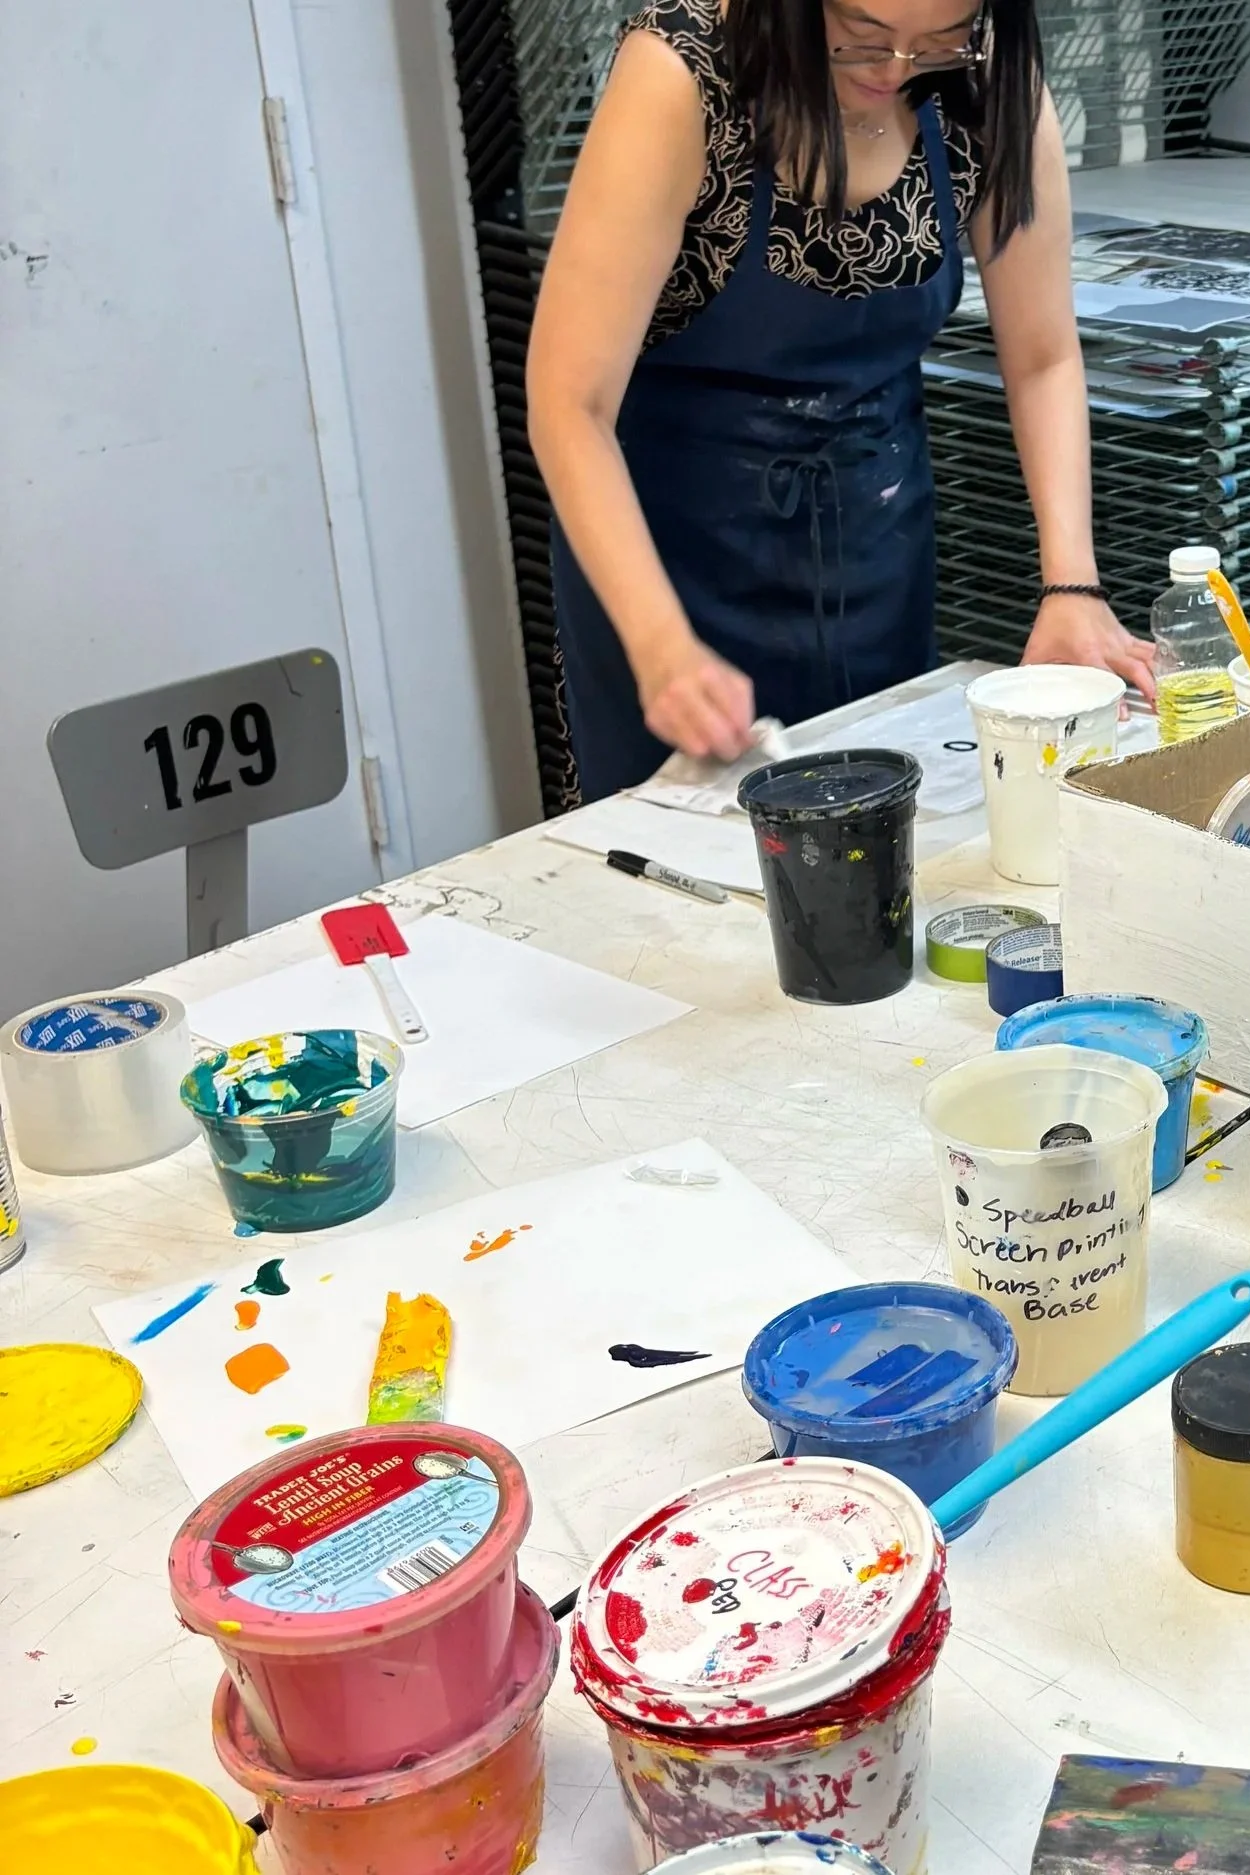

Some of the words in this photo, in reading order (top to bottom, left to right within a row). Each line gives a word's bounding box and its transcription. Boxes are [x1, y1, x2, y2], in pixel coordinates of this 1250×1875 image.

[144, 702, 277, 810] 129
[65, 1029, 86, 1049] LUX
[983, 1190, 1116, 1233] Speedball
[955, 1220, 1048, 1263] Screen
[1023, 1292, 1101, 1321] Base
[251, 1521, 274, 1541] WITH
[278, 1482, 349, 1527] Ancient
[346, 1455, 404, 1489] Grains
[253, 1476, 309, 1507] TRADER
[309, 1453, 347, 1479] JOE'S
[264, 1481, 320, 1516] Lentil
[316, 1461, 363, 1488] Soup
[302, 1507, 333, 1527] HIGH
[333, 1500, 347, 1512] IN
[345, 1484, 376, 1505] FIBER
[727, 1550, 813, 1599] CLASS
